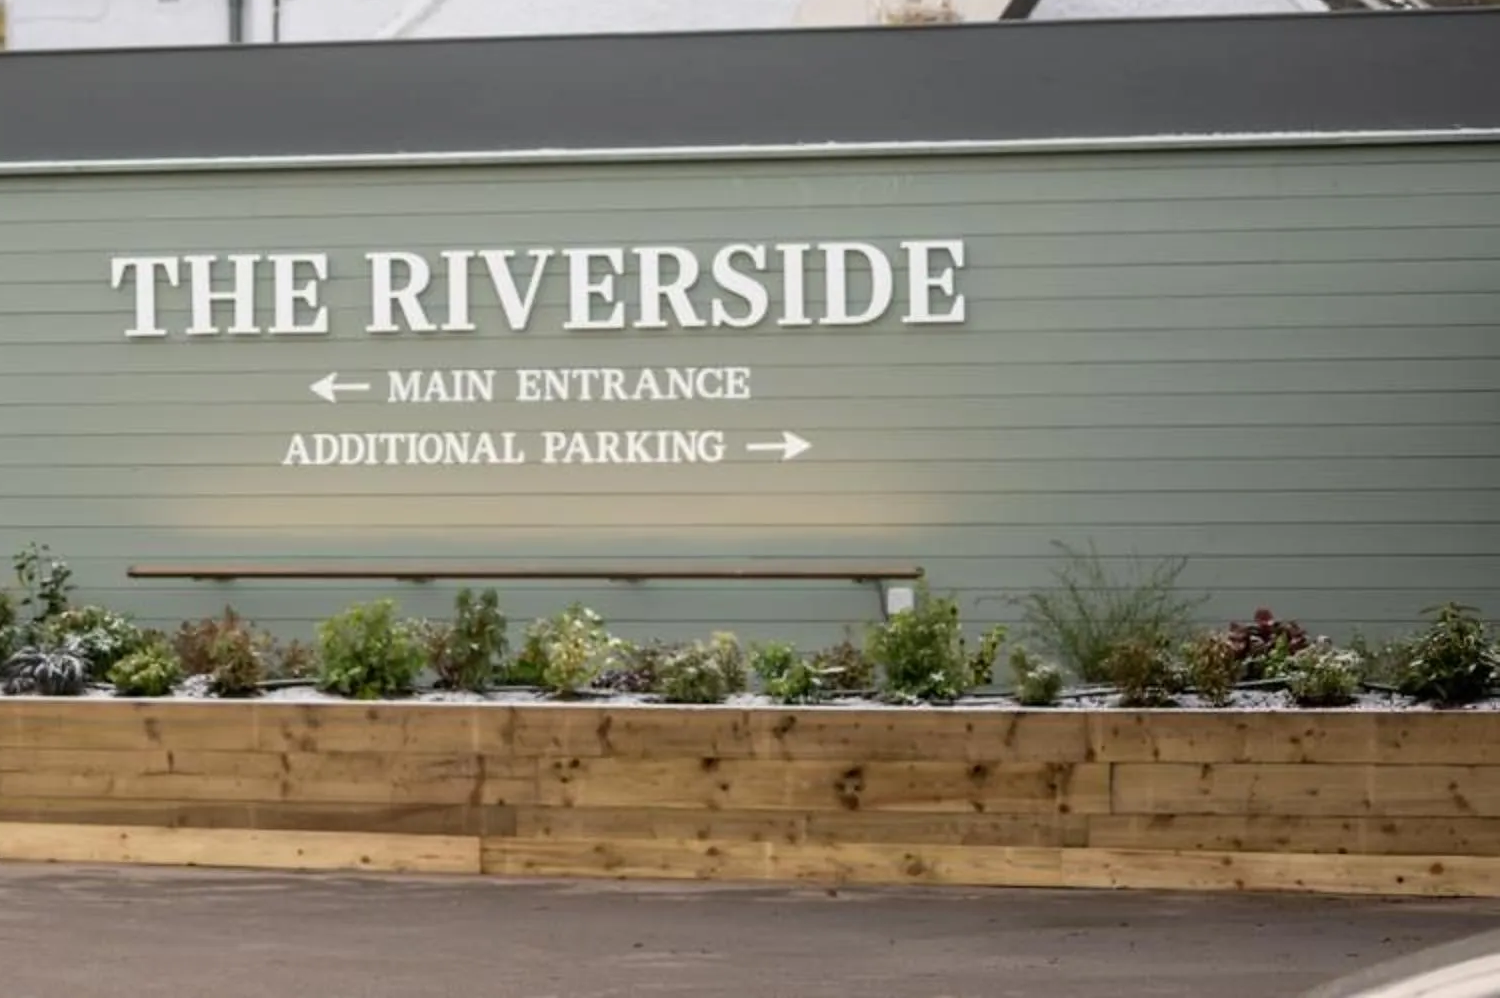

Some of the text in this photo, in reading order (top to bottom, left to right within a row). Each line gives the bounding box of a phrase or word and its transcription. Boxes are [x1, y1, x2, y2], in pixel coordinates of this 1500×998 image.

[110, 239, 966, 337] THE RIVERSIDE
[387, 367, 751, 402] MAIN ENTRANCE
[282, 431, 726, 465] ADDITIONAL PARKING
